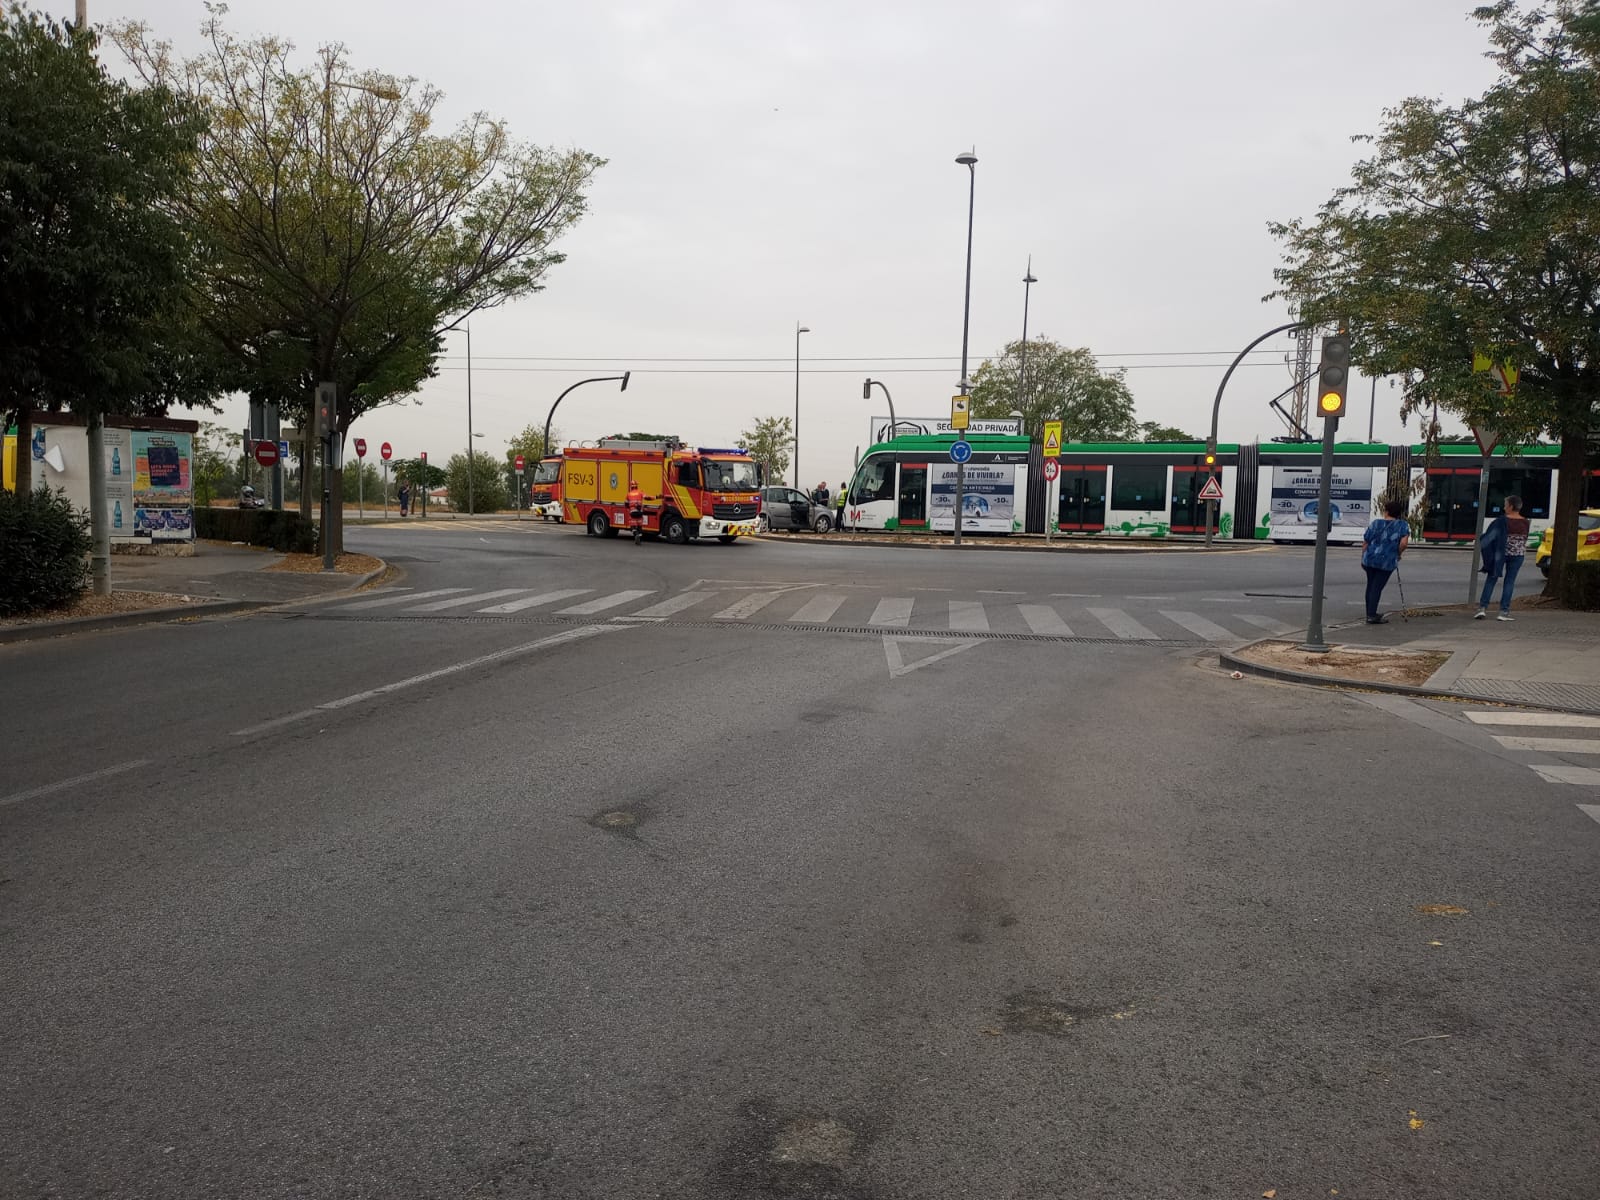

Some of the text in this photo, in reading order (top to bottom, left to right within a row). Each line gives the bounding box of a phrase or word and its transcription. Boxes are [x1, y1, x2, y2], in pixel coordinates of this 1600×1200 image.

[985, 424, 1019, 432] PRIVADA
[942, 471, 966, 479] ¿GANS
[568, 473, 594, 486] FSV-3
